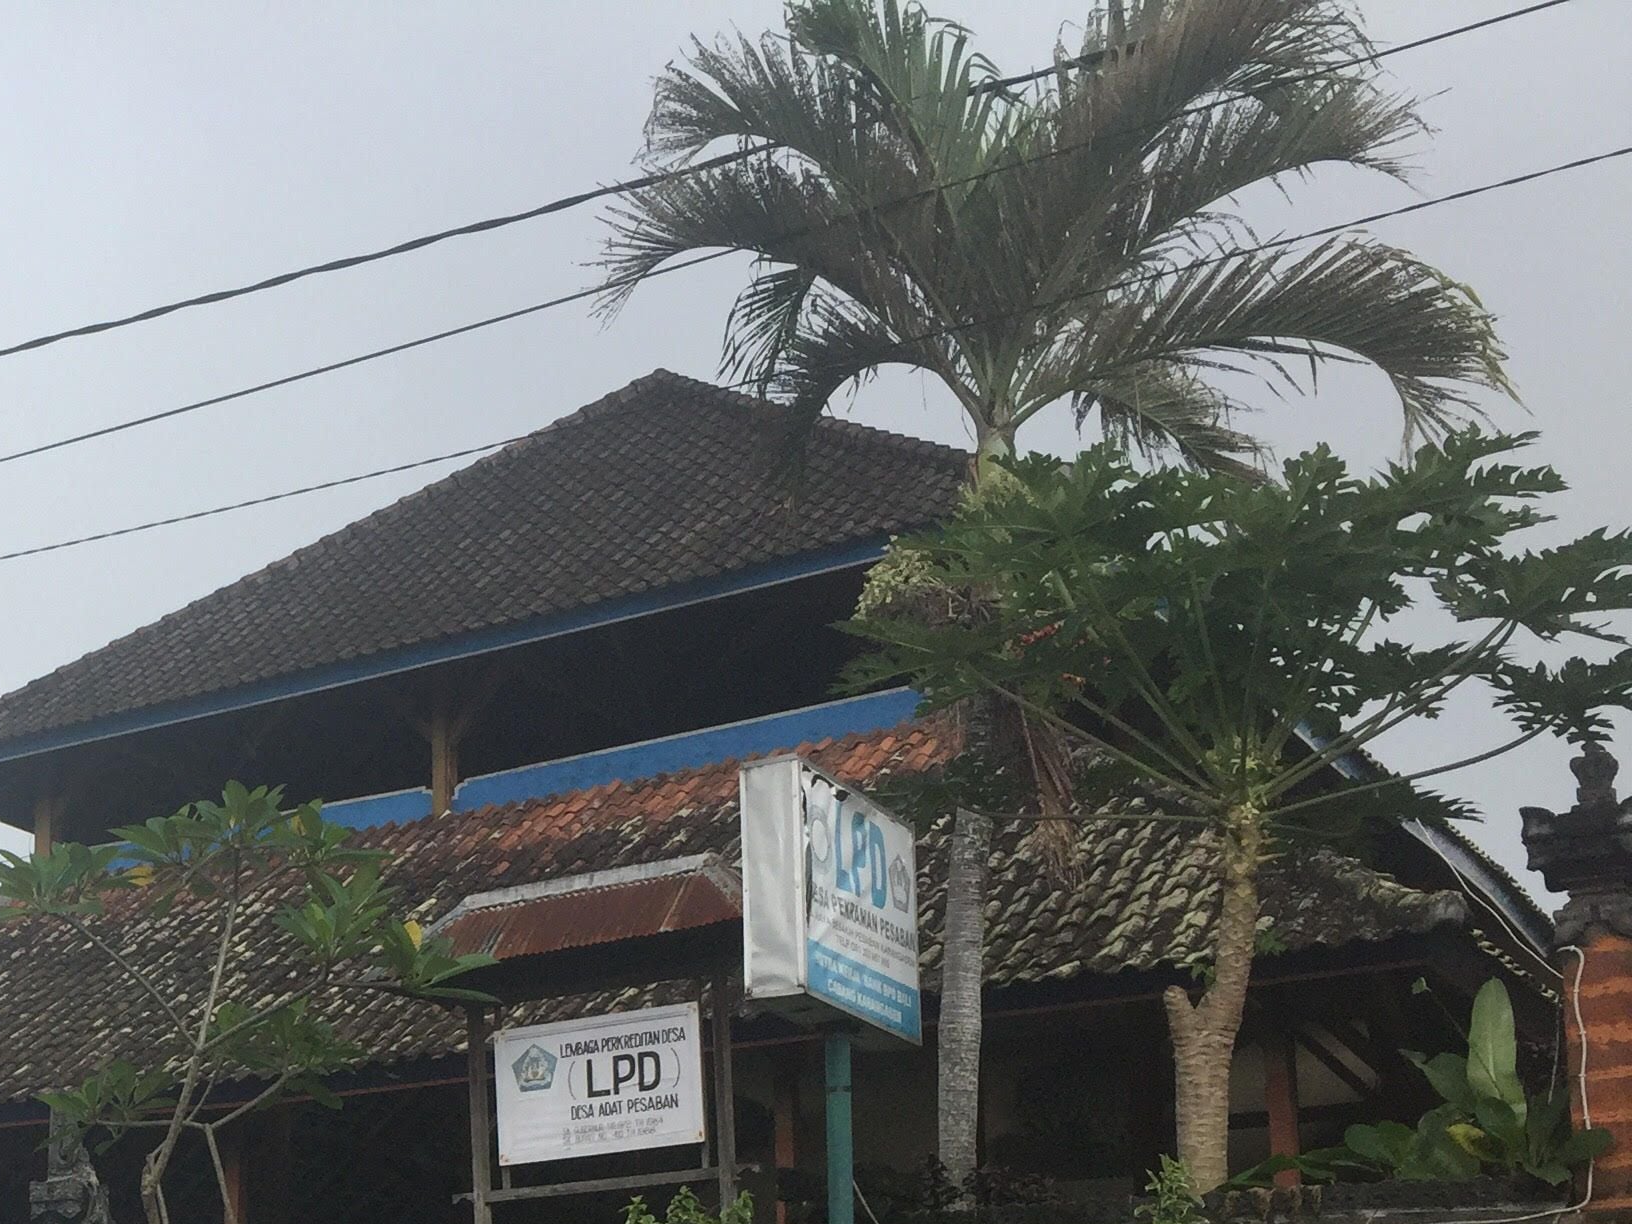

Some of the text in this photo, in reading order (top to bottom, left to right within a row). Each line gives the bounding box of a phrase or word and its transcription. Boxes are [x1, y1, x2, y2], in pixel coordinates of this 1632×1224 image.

[835, 800, 887, 910] LPD
[811, 881, 829, 911] ESA
[560, 1040, 599, 1058] LEMBAGA
[662, 1027, 686, 1045] DESA
[571, 1093, 679, 1120] DESA ADAT PESABAN
